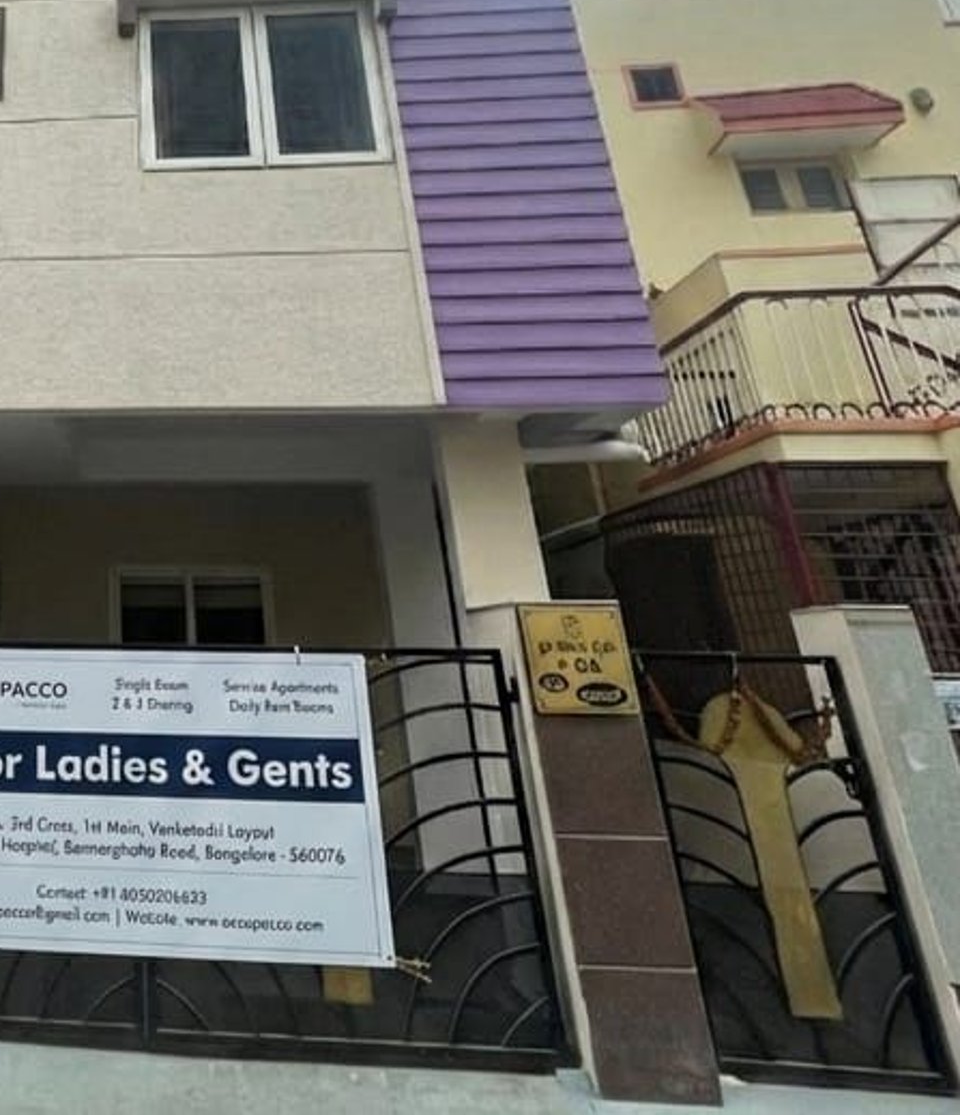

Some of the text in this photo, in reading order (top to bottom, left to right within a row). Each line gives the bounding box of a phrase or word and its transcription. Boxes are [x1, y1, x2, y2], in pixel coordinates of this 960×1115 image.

[36, 743, 169, 784] Ladies
[182, 748, 215, 786] &
[227, 748, 353, 790] Gents
[289, 846, 346, 866] 560076
